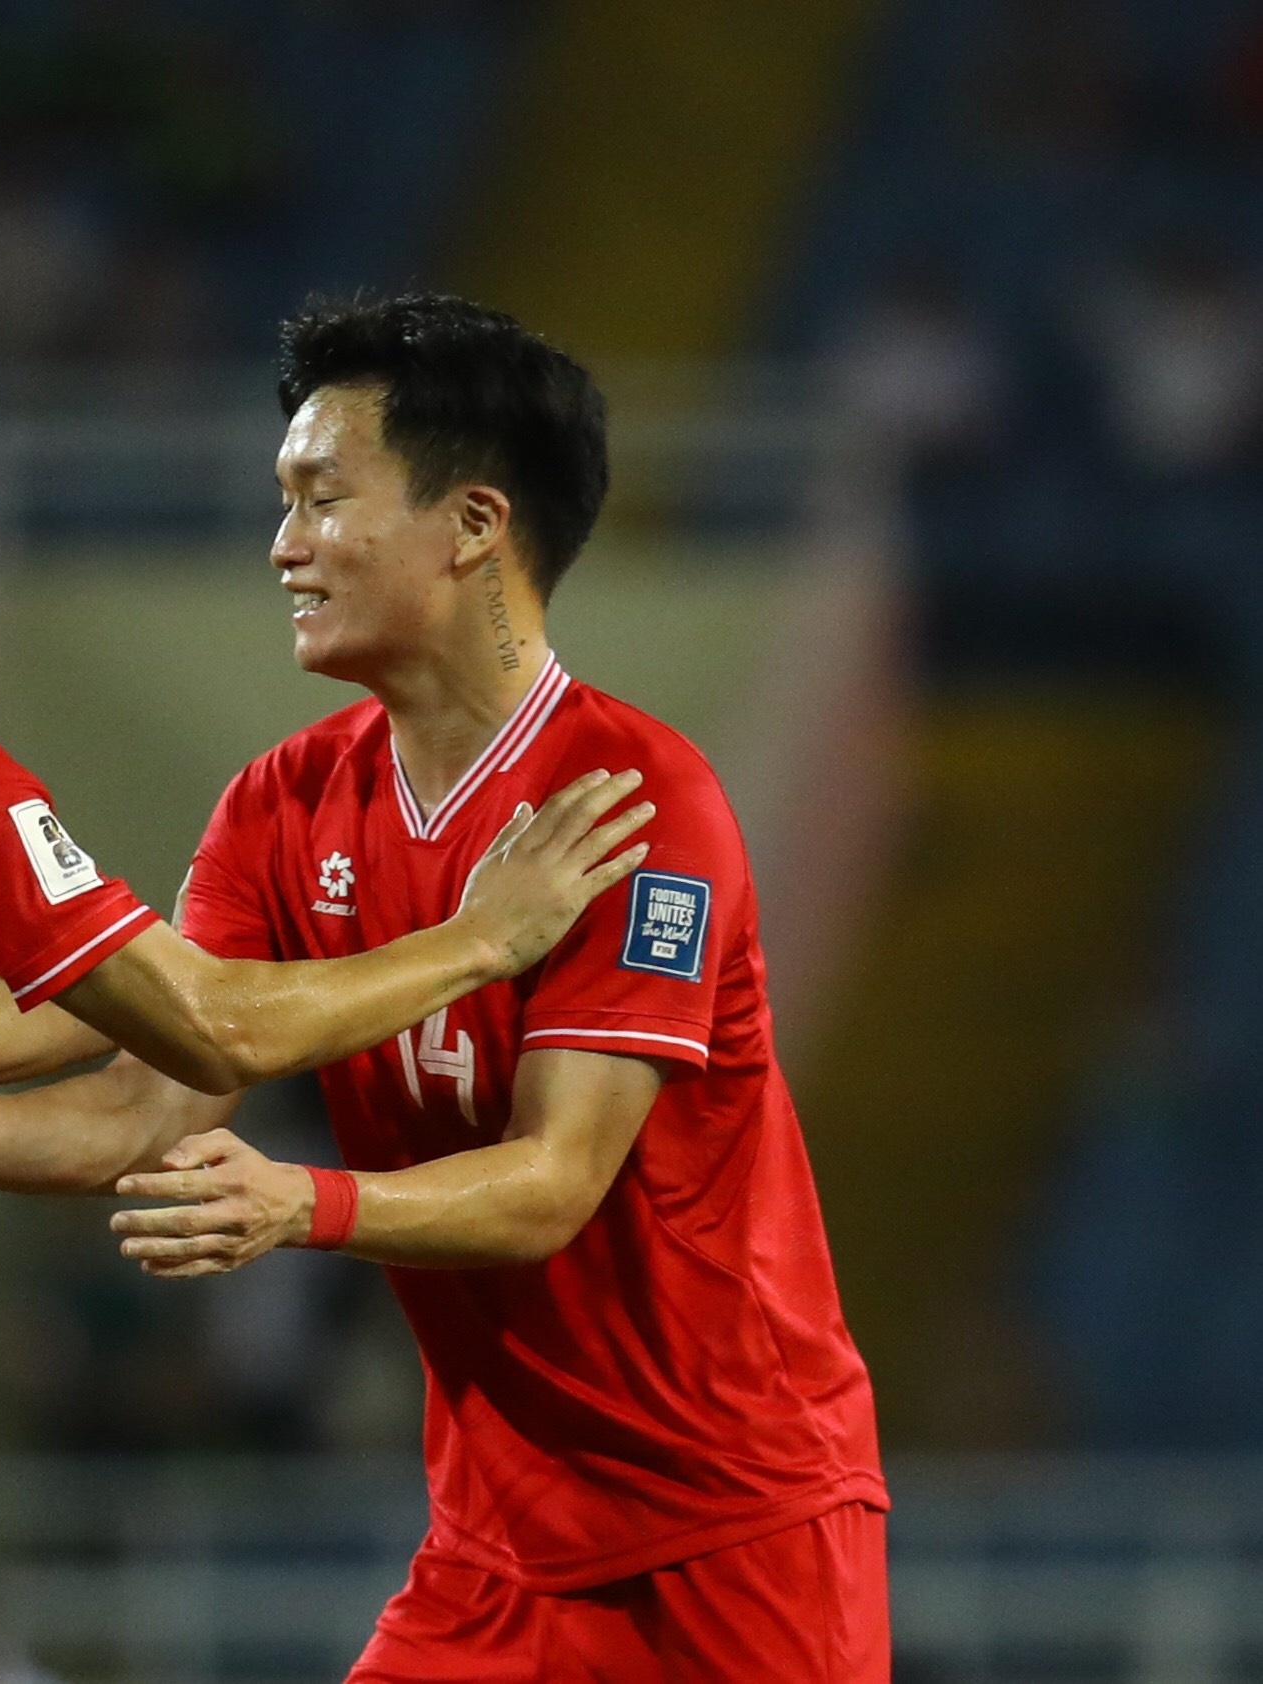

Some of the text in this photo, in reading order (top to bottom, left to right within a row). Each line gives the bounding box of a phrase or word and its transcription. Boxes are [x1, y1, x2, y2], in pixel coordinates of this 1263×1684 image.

[649, 887, 697, 908] FOOTBALL
[647, 901, 695, 927] UNITES
[641, 921, 694, 945] the World
[397, 1005, 478, 1127] 14
